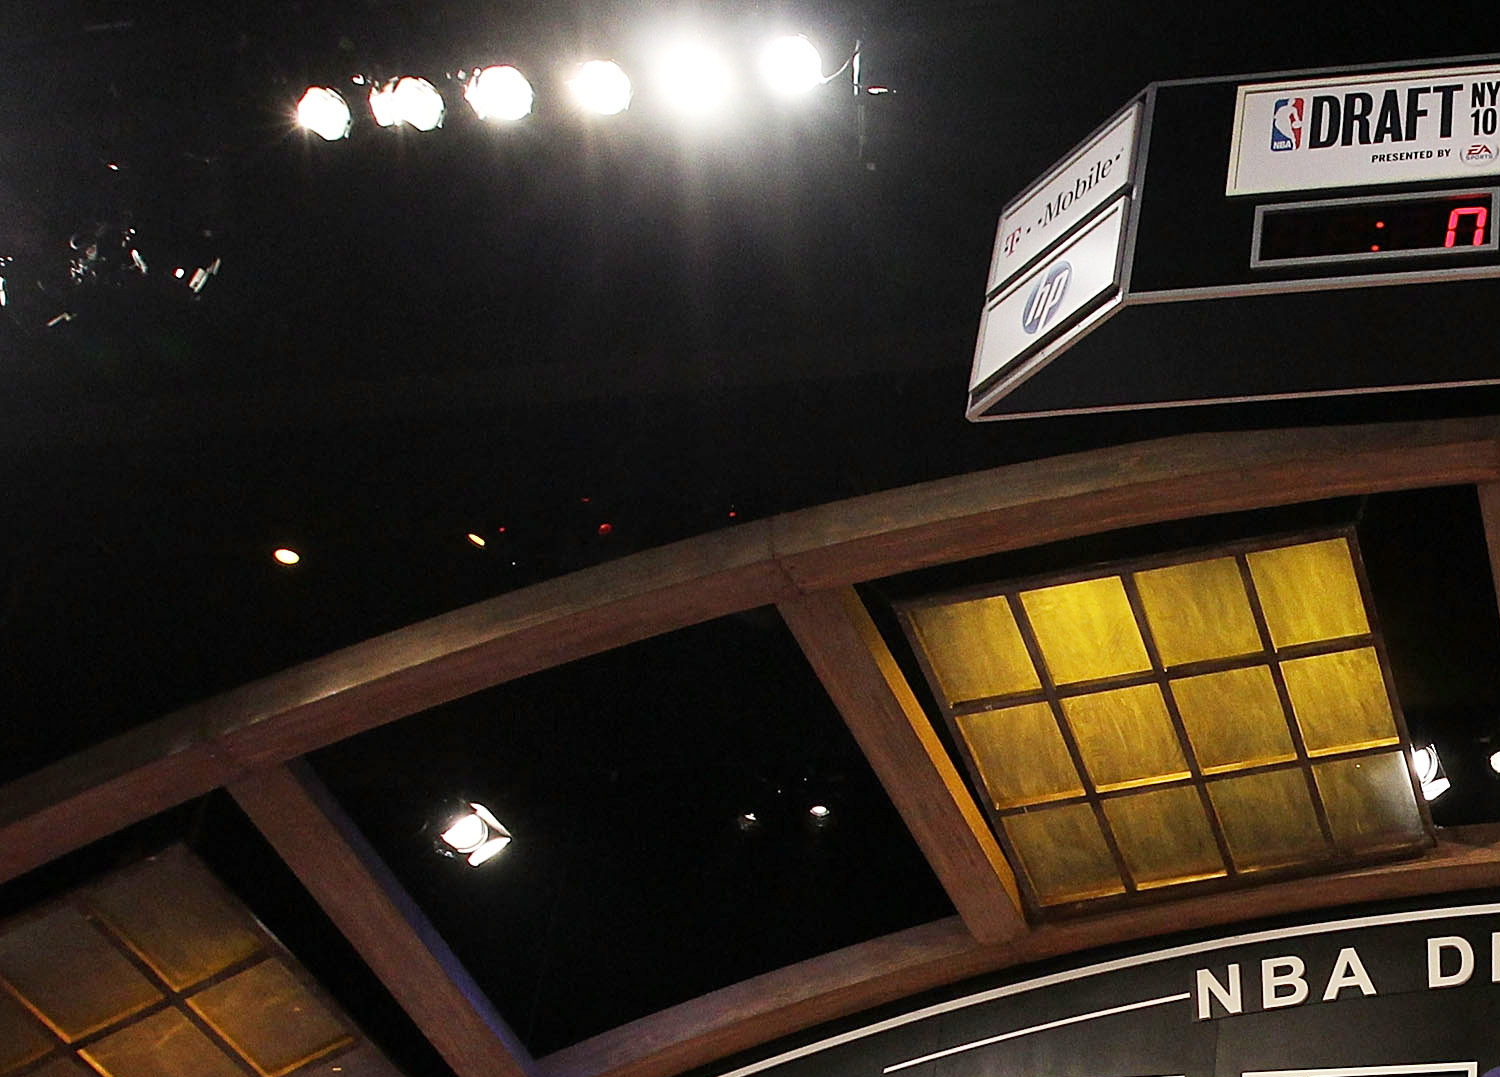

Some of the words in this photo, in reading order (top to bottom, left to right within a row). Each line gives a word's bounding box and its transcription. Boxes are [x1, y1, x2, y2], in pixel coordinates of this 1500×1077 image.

[1308, 84, 1463, 149] DRAFT
[1470, 108, 1498, 135] 10
[1273, 140, 1292, 150] NBA
[1371, 150, 1433, 163] PRESENTED
[1436, 149, 1451, 158] BY
[1467, 144, 1492, 155] EA
[1025, 268, 1070, 331] hp
[1197, 947, 1377, 1019] NBA
